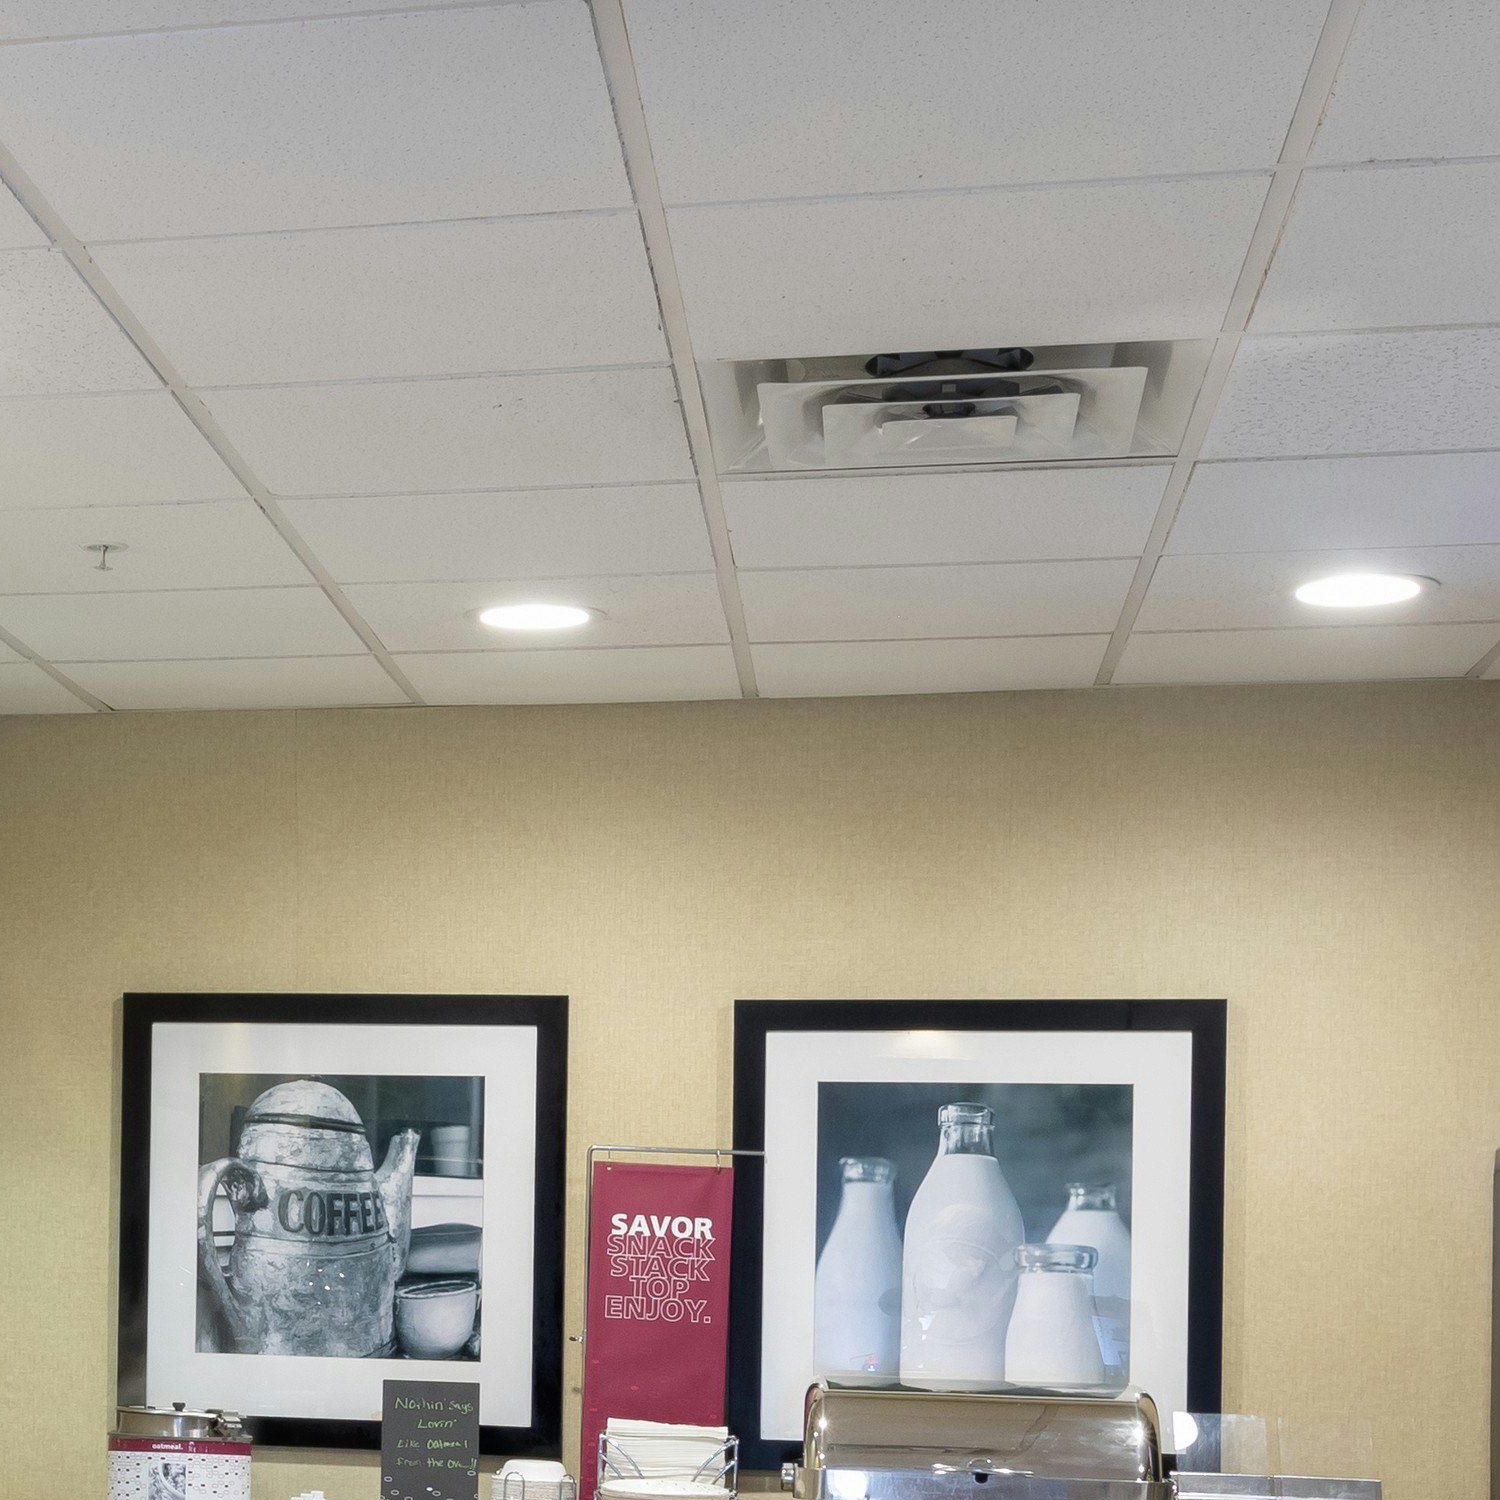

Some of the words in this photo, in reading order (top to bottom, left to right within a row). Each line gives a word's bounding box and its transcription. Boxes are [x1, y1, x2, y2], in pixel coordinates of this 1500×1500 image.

[278, 1190, 384, 1236] COFFEE
[611, 1213, 713, 1240] SAVOR
[606, 1232, 716, 1260] SNACK
[610, 1253, 710, 1282] STACK
[629, 1275, 690, 1300] TOP
[604, 1294, 711, 1324] ENJOY.
